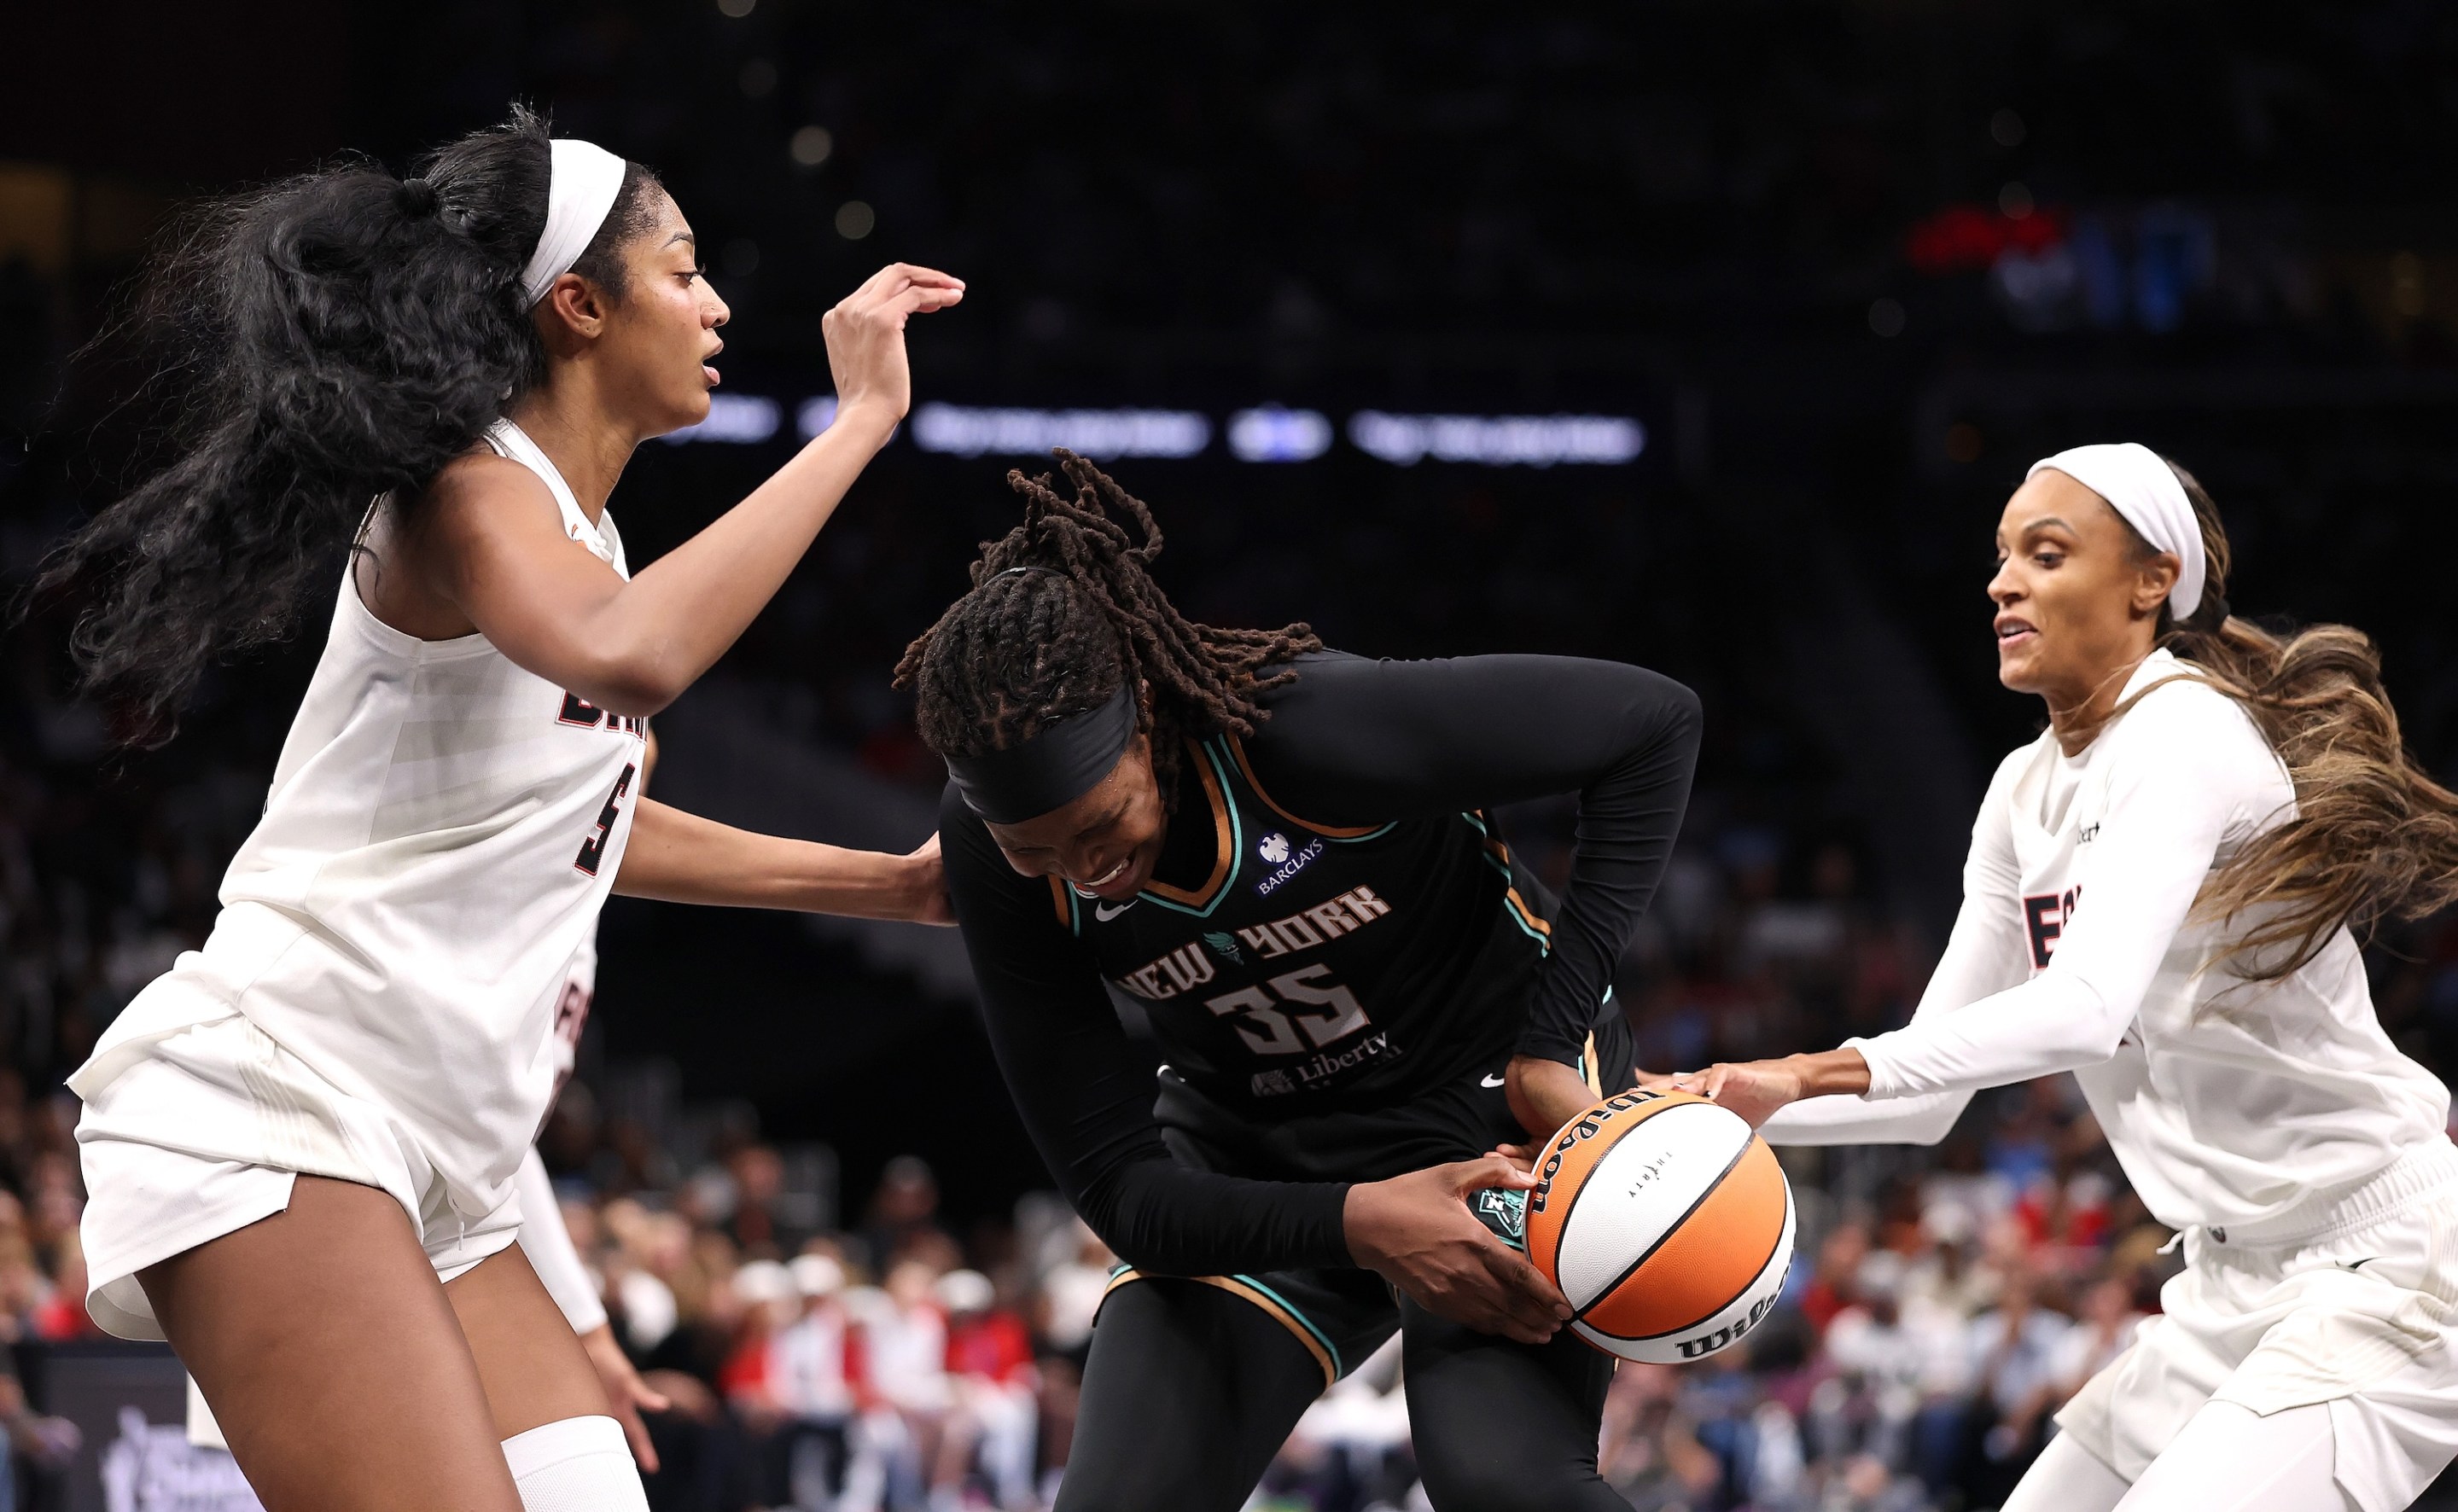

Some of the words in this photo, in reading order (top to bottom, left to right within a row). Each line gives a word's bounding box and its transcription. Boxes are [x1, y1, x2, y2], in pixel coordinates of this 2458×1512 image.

[573, 761, 636, 878] 5
[1258, 838, 1324, 895] BARCLAYS
[1115, 940, 1216, 1000] NEW
[1237, 885, 1391, 958] YORK
[1204, 962, 1371, 1055] 35
[1294, 1030, 1389, 1083] Liberty
[1533, 1091, 1667, 1213] Wilson
